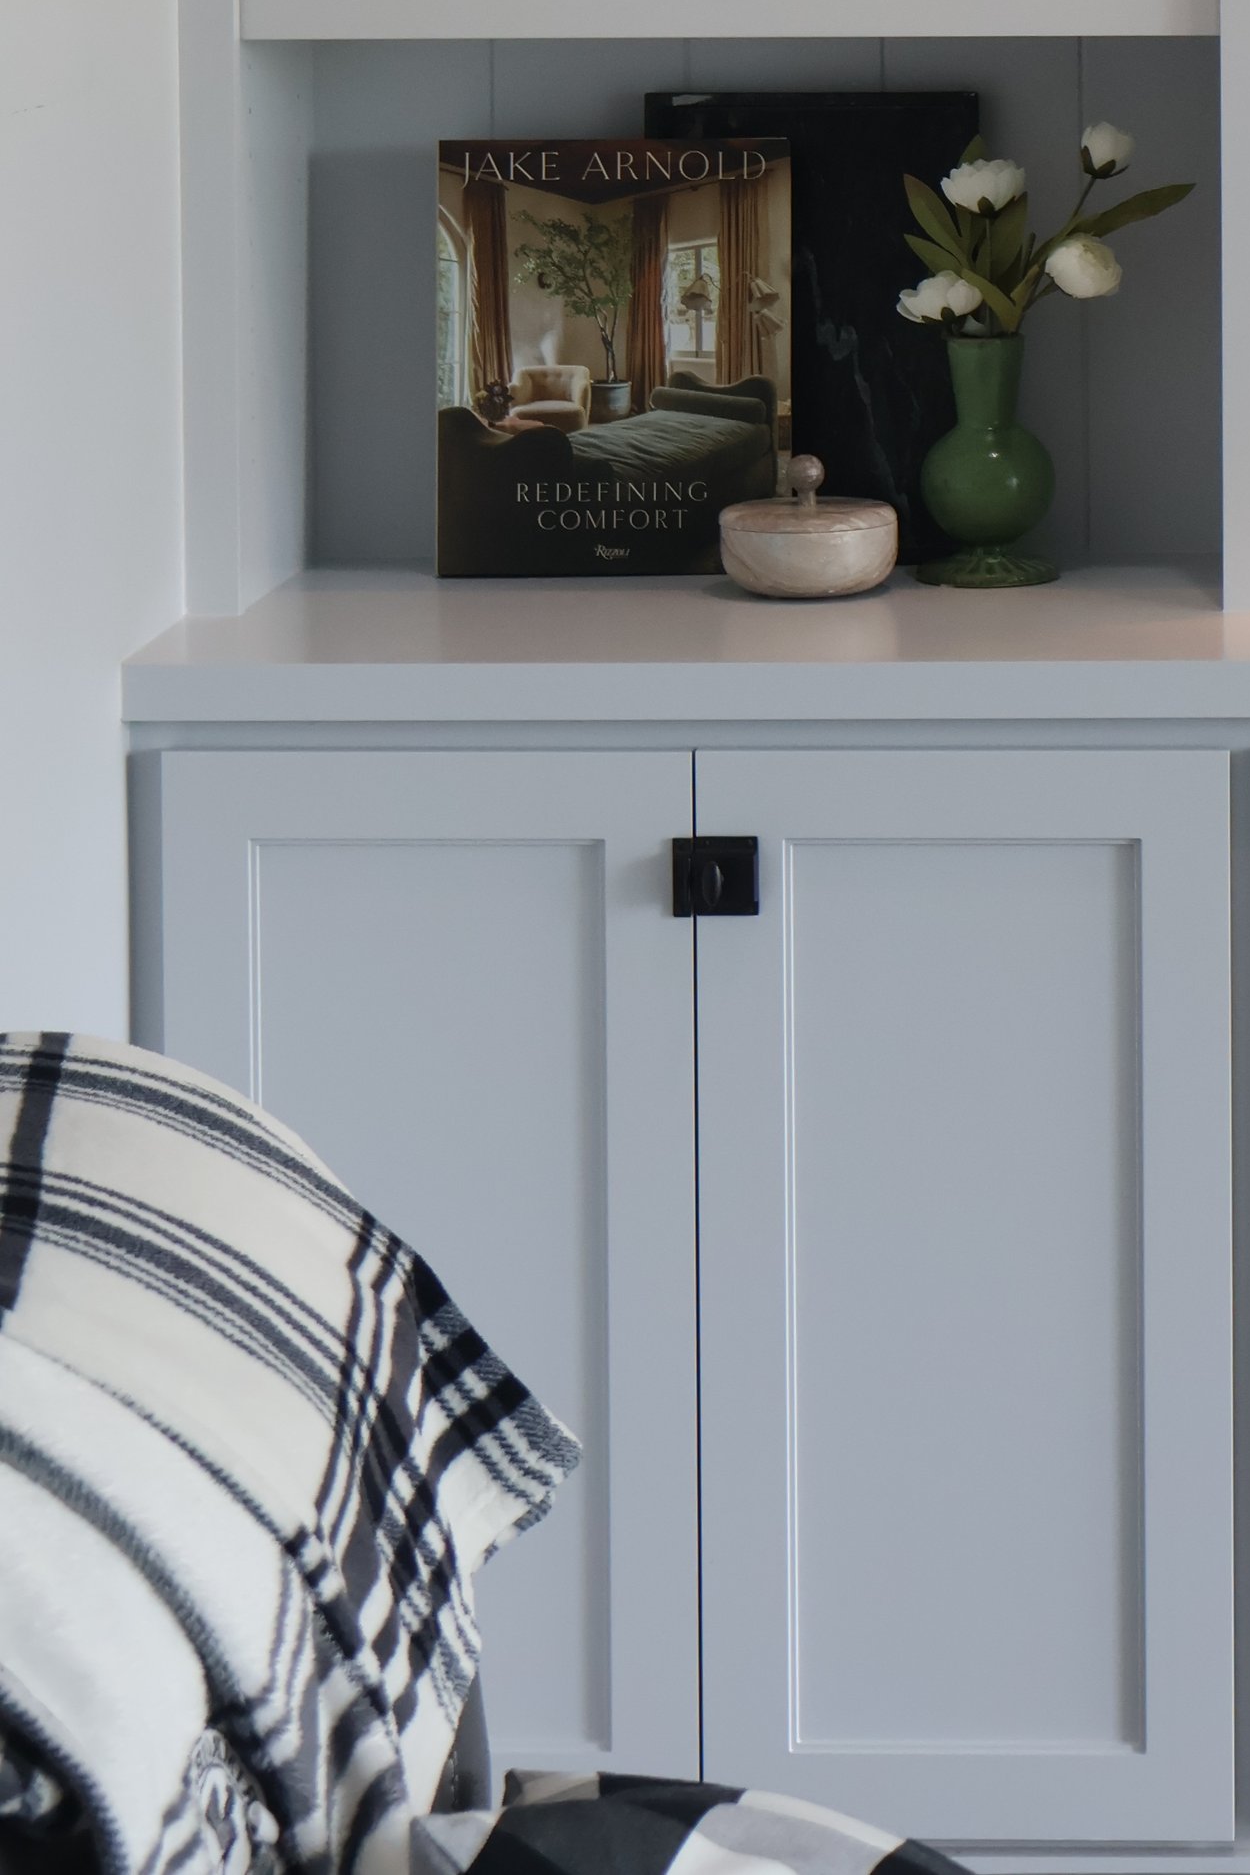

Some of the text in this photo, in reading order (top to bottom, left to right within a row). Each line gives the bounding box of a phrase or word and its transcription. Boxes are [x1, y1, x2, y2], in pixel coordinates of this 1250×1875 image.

[461, 149, 767, 189] JAKE ARNOLD
[516, 480, 709, 504] REDEFINING
[537, 508, 688, 531] COMFORT
